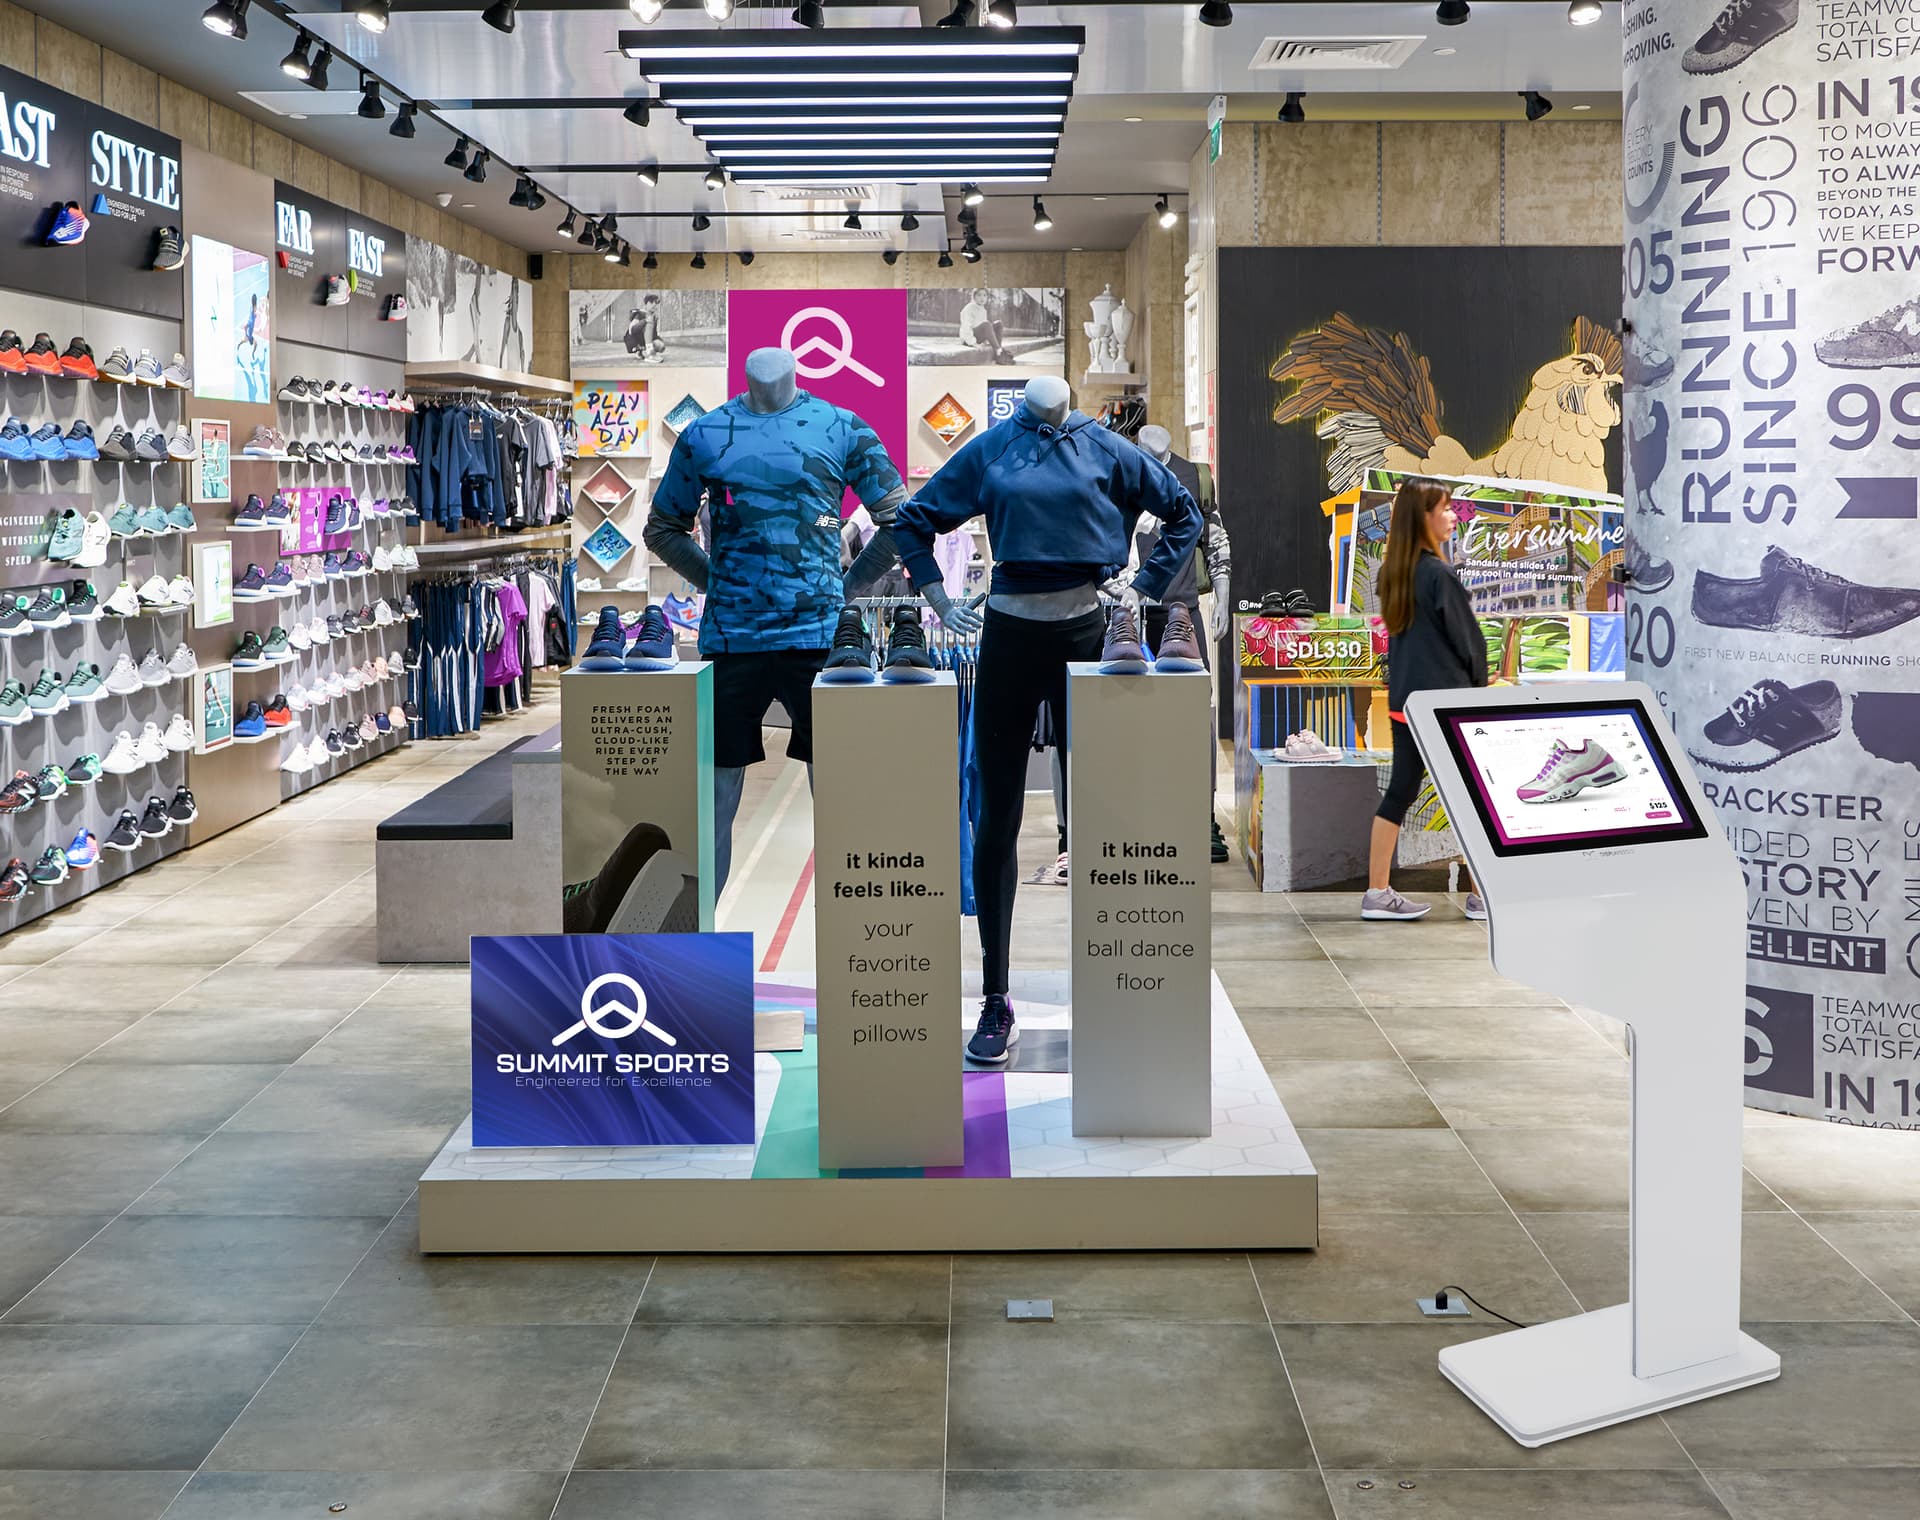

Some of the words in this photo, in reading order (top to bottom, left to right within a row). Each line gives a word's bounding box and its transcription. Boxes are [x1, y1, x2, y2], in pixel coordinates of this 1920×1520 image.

[1624, 7, 1657, 38] SHING.
[1816, 19, 1887, 39] TOTAL
[1894, 17, 1920, 33] CU
[1818, 78, 1869, 119] IN
[1818, 125, 1848, 142] TO
[1856, 121, 1920, 139] MOVE
[1818, 147, 1844, 162] TO
[1851, 143, 1920, 160] ALWAY
[91, 130, 179, 211] STYLE
[1628, 160, 1654, 180] COUNTS
[1742, 84, 1797, 262] 1906
[1818, 168, 1849, 184] TO
[1818, 187, 1882, 202] BEYOND
[1888, 186, 1917, 198] THE
[1818, 204, 1884, 220] TODAY,
[1890, 204, 1914, 217] AS
[276, 201, 315, 255] FAR
[1818, 226, 1855, 243] WE
[1863, 223, 1920, 241] KEEP
[348, 228, 385, 277] FAST
[1818, 245, 1920, 275] FORW
[1623, 231, 1674, 303] 05
[1680, 95, 1731, 524] RUNNING
[587, 393, 639, 414] PLAY
[1742, 289, 1797, 526] SINCE
[591, 411, 629, 431] ALL
[600, 427, 639, 447] DAY
[5, 555, 32, 566] SPEED
[1466, 558, 1499, 568] Sandals
[1501, 560, 1517, 569] and
[1520, 561, 1544, 570] slides
[1547, 562, 1559, 571] for
[1480, 569, 1501, 577] cool
[1503, 570, 1511, 578] in
[1514, 570, 1546, 580] endless
[1286, 641, 1361, 659] SDL330
[1684, 647, 1712, 658] FIRST
[1717, 649, 1744, 661] NEW
[1749, 651, 1816, 665] BALANCE
[1821, 655, 1891, 666] RUNNING
[1896, 656, 1920, 667] SHO
[592, 705, 631, 714] FRESH
[637, 705, 671, 714] FOAM
[591, 716, 650, 724] DELIVERS
[656, 716, 673, 724] AN
[591, 726, 672, 735] ULTRA-CUSH,
[594, 736, 669, 745] CLOUD-LIKE
[595, 747, 624, 755] RIDE
[630, 747, 668, 755] EVERY
[606, 757, 636, 765] STEP
[641, 757, 657, 765] OF
[605, 768, 628, 776] THE
[633, 768, 659, 776] WAY
[1700, 781, 1883, 821] RACKSTER
[1102, 842, 1116, 858] it
[1122, 842, 1177, 858] kinda
[1727, 826, 1810, 859] IDED
[1833, 837, 1880, 864] BY
[846, 853, 860, 869] it
[868, 852, 925, 869] kinda
[1089, 869, 1137, 885] feels
[1144, 869, 1196, 885] like...
[834, 882, 883, 898] feels
[890, 881, 944, 897] like...
[1096, 910, 1108, 923] a
[1115, 907, 1184, 924] cotton
[1832, 906, 1880, 934] BY
[864, 922, 913, 941] your
[1087, 939, 1123, 957] ball
[1130, 939, 1195, 957] dance
[848, 954, 930, 973] favorite
[1117, 973, 1165, 990] floor
[852, 990, 928, 1008] feather
[853, 1024, 928, 1045] pillows
[1822, 1015, 1890, 1037] TOTAL
[1897, 1022, 1920, 1038] CU
[496, 1053, 608, 1073] SUMMIT
[615, 1053, 730, 1073] SPORTS
[515, 1076, 600, 1089] Engineered
[606, 1076, 626, 1087] for
[632, 1076, 712, 1087] Excellence
[1824, 1071, 1875, 1114] IN
[1893, 1079, 1920, 1117] 1
